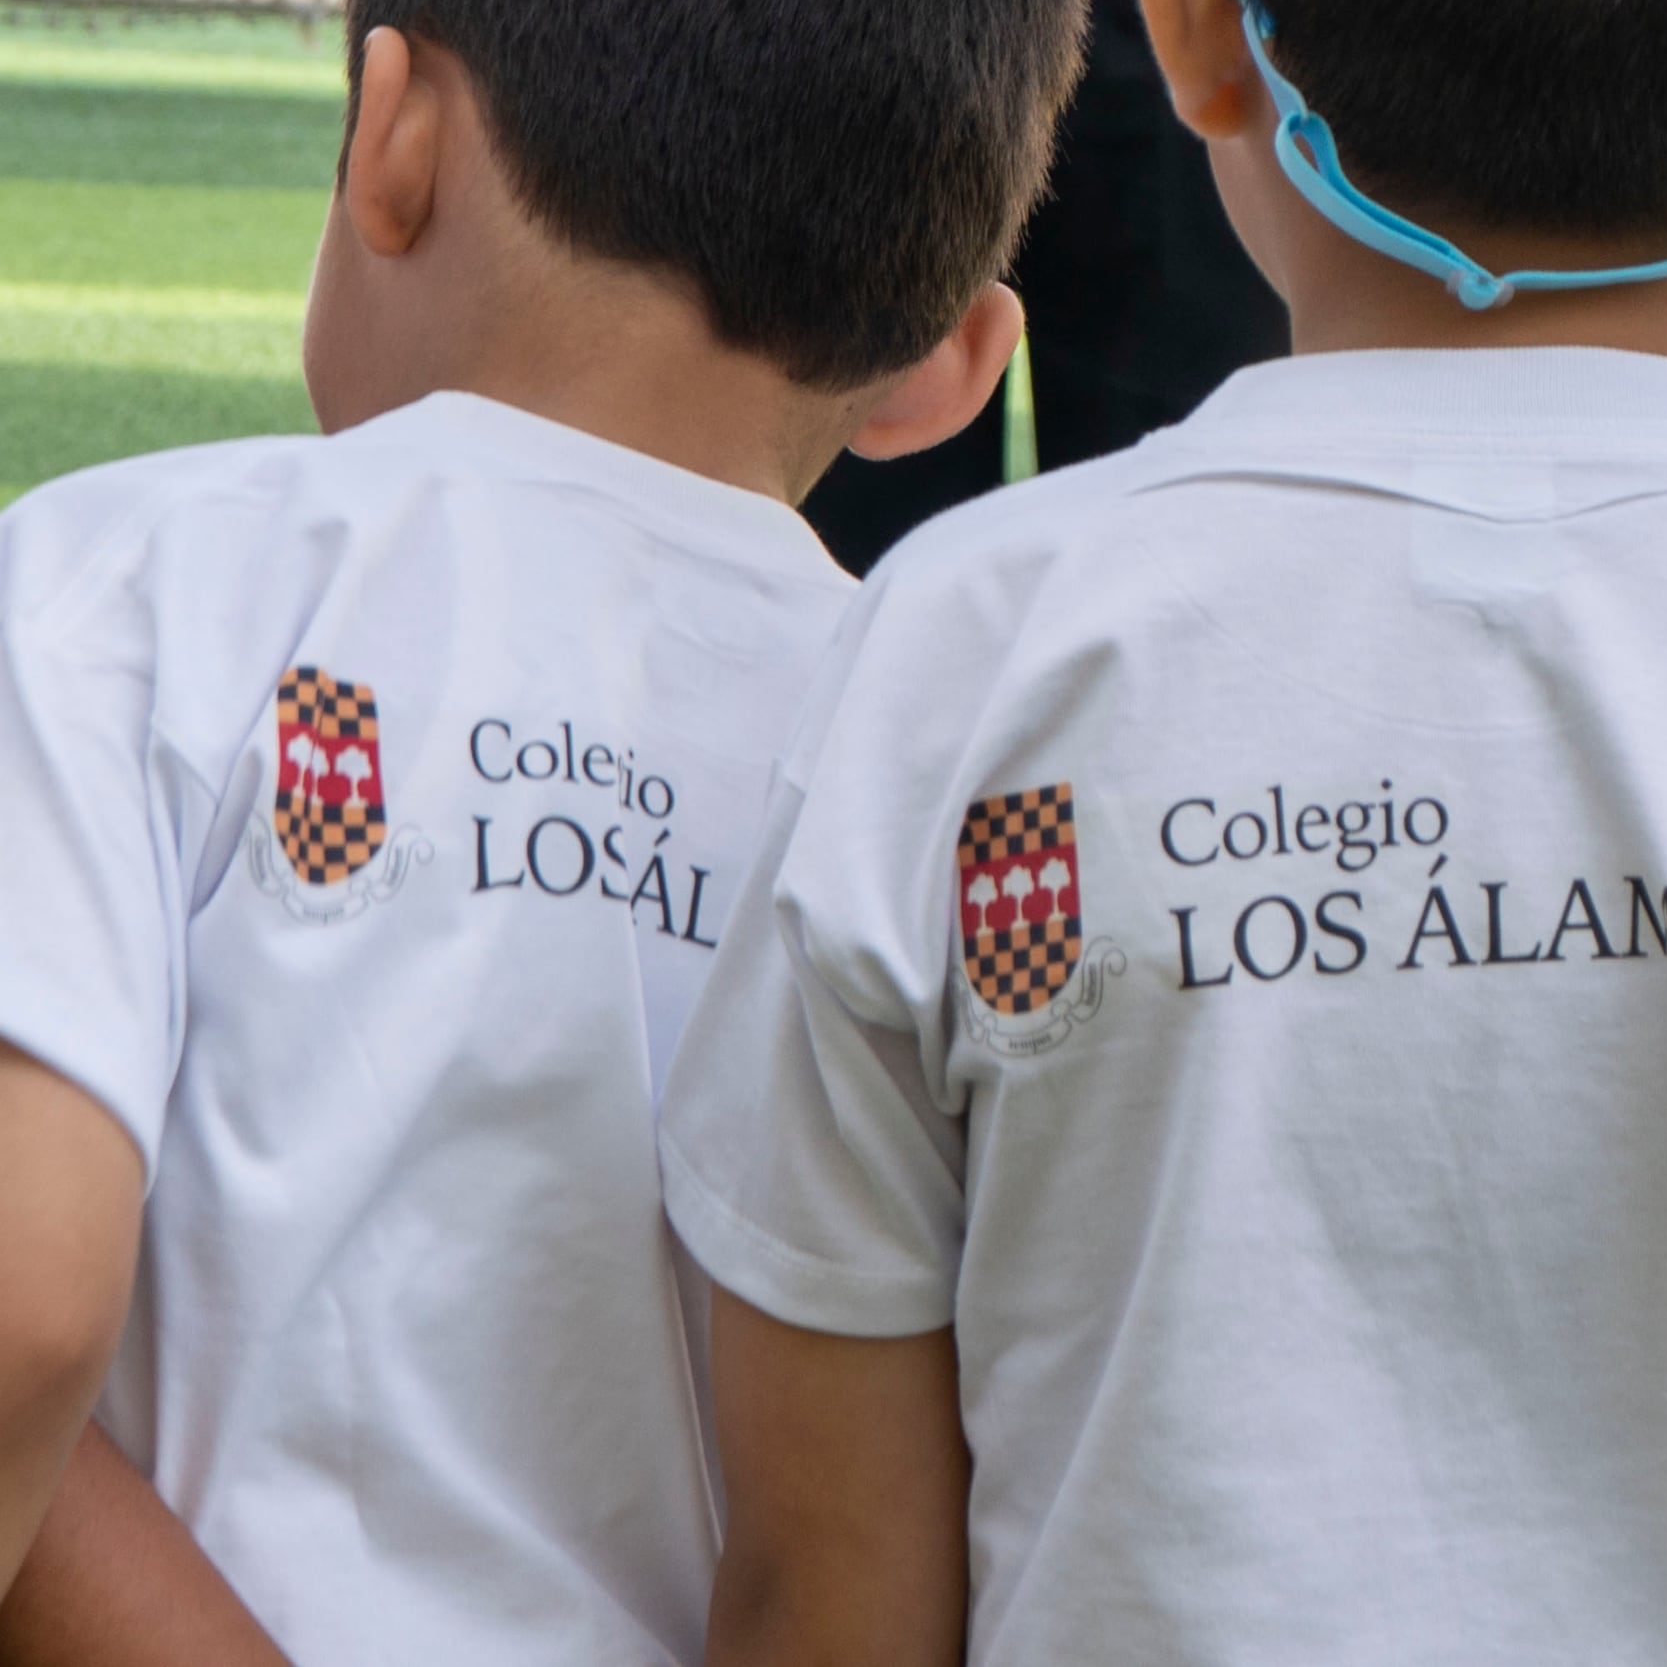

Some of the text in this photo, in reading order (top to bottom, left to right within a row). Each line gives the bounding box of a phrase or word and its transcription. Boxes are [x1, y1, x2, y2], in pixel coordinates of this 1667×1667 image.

[469, 718, 675, 819] Coleio
[471, 814, 630, 900] LOS
[1160, 778, 1449, 873] Colegio
[1169, 889, 1368, 992] LOS
